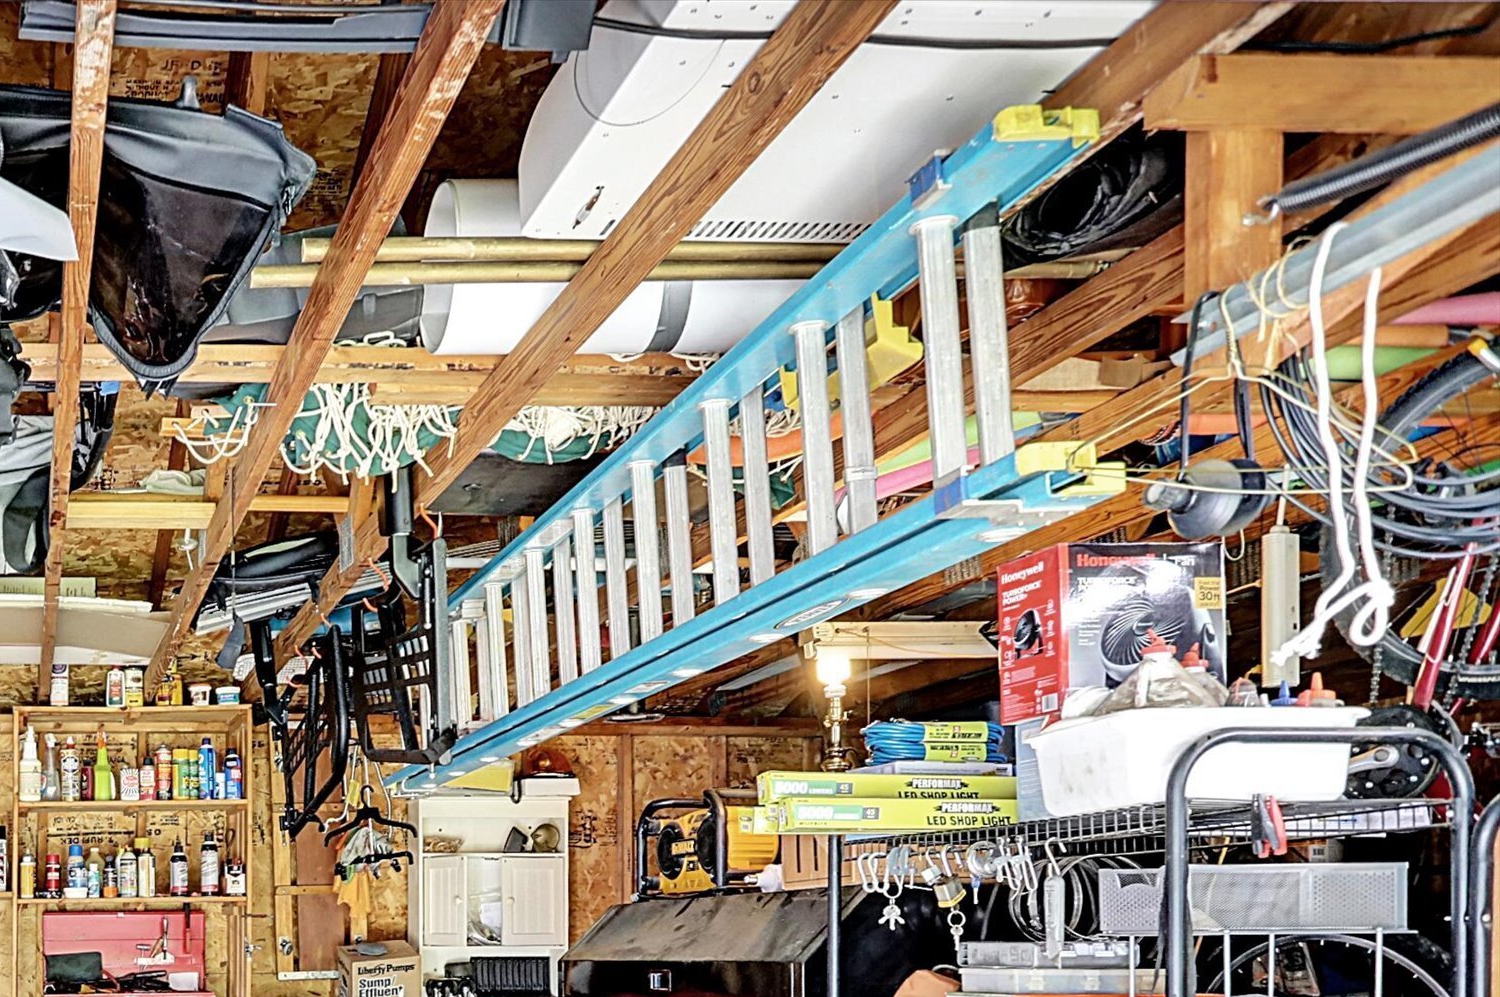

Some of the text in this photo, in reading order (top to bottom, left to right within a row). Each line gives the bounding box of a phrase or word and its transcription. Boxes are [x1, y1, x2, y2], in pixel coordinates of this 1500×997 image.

[1001, 561, 1044, 585] Honeywell
[1200, 591, 1213, 600] 30
[912, 778, 962, 789] PERFORMAX
[951, 791, 980, 799] LIGHT
[940, 802, 994, 813] PERFORMAX
[926, 815, 1011, 826] LED SHOP LIGHT
[357, 964, 415, 975] Liberty Pumps
[359, 986, 403, 997] Effluen
